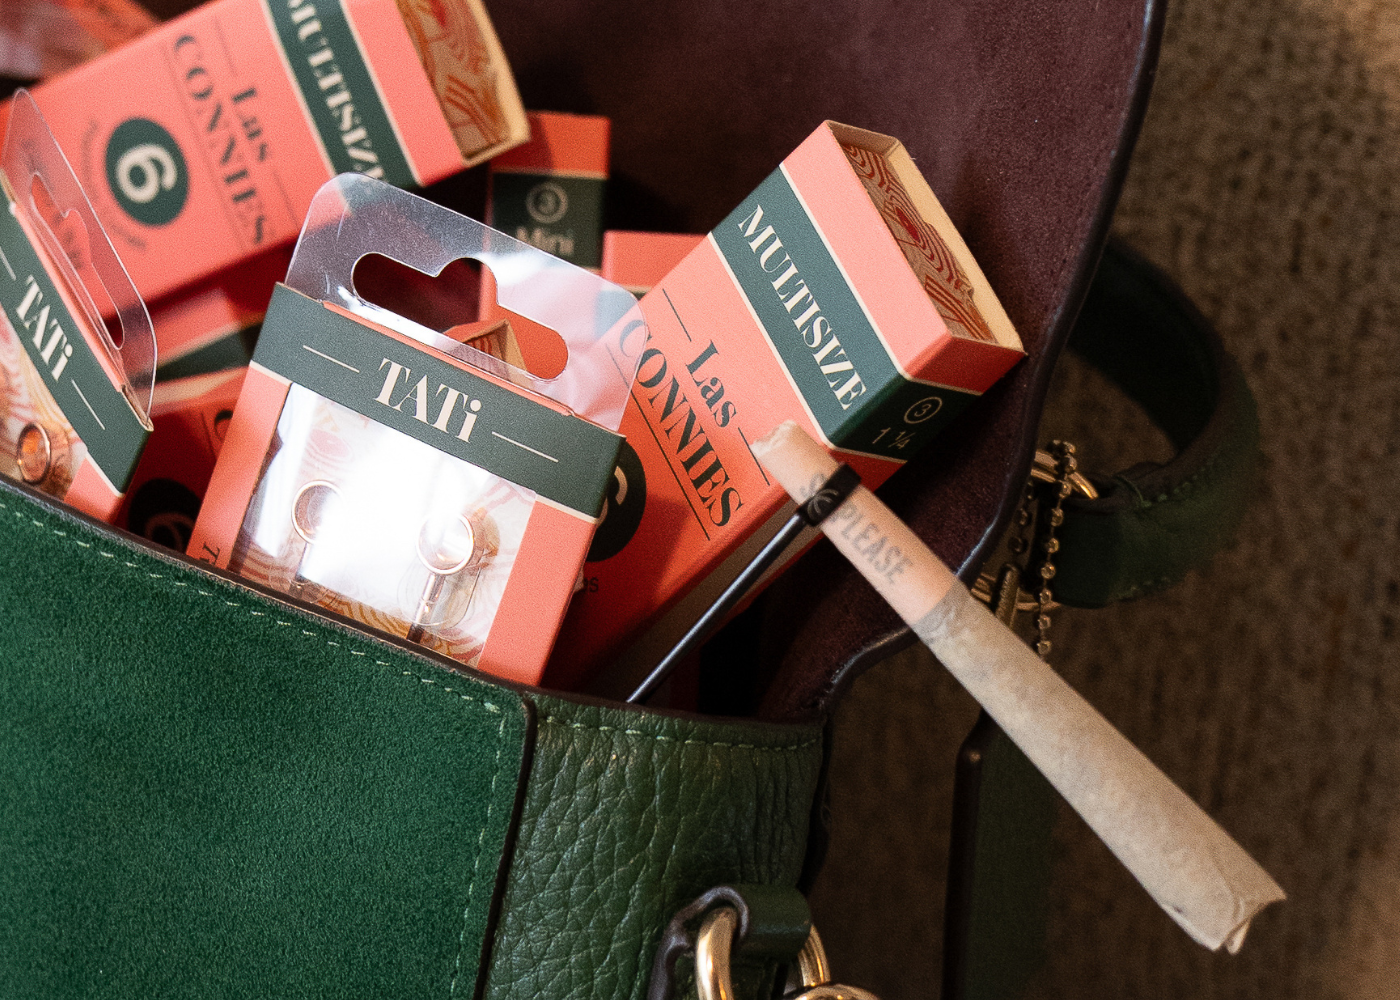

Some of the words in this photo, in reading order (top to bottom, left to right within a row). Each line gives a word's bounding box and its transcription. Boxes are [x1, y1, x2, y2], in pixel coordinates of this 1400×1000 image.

[173, 33, 267, 245] CONNIES
[231, 85, 269, 163] Las
[116, 144, 178, 204] 6
[16, 273, 74, 382] TATi
[738, 204, 868, 411] MULTISIZE
[373, 357, 482, 444] TATi
[618, 318, 745, 528] CONNIES
[685, 339, 740, 429] Las
[913, 402, 933, 418] 3
[872, 426, 892, 445] 1
[829, 500, 914, 584] PLEASE
